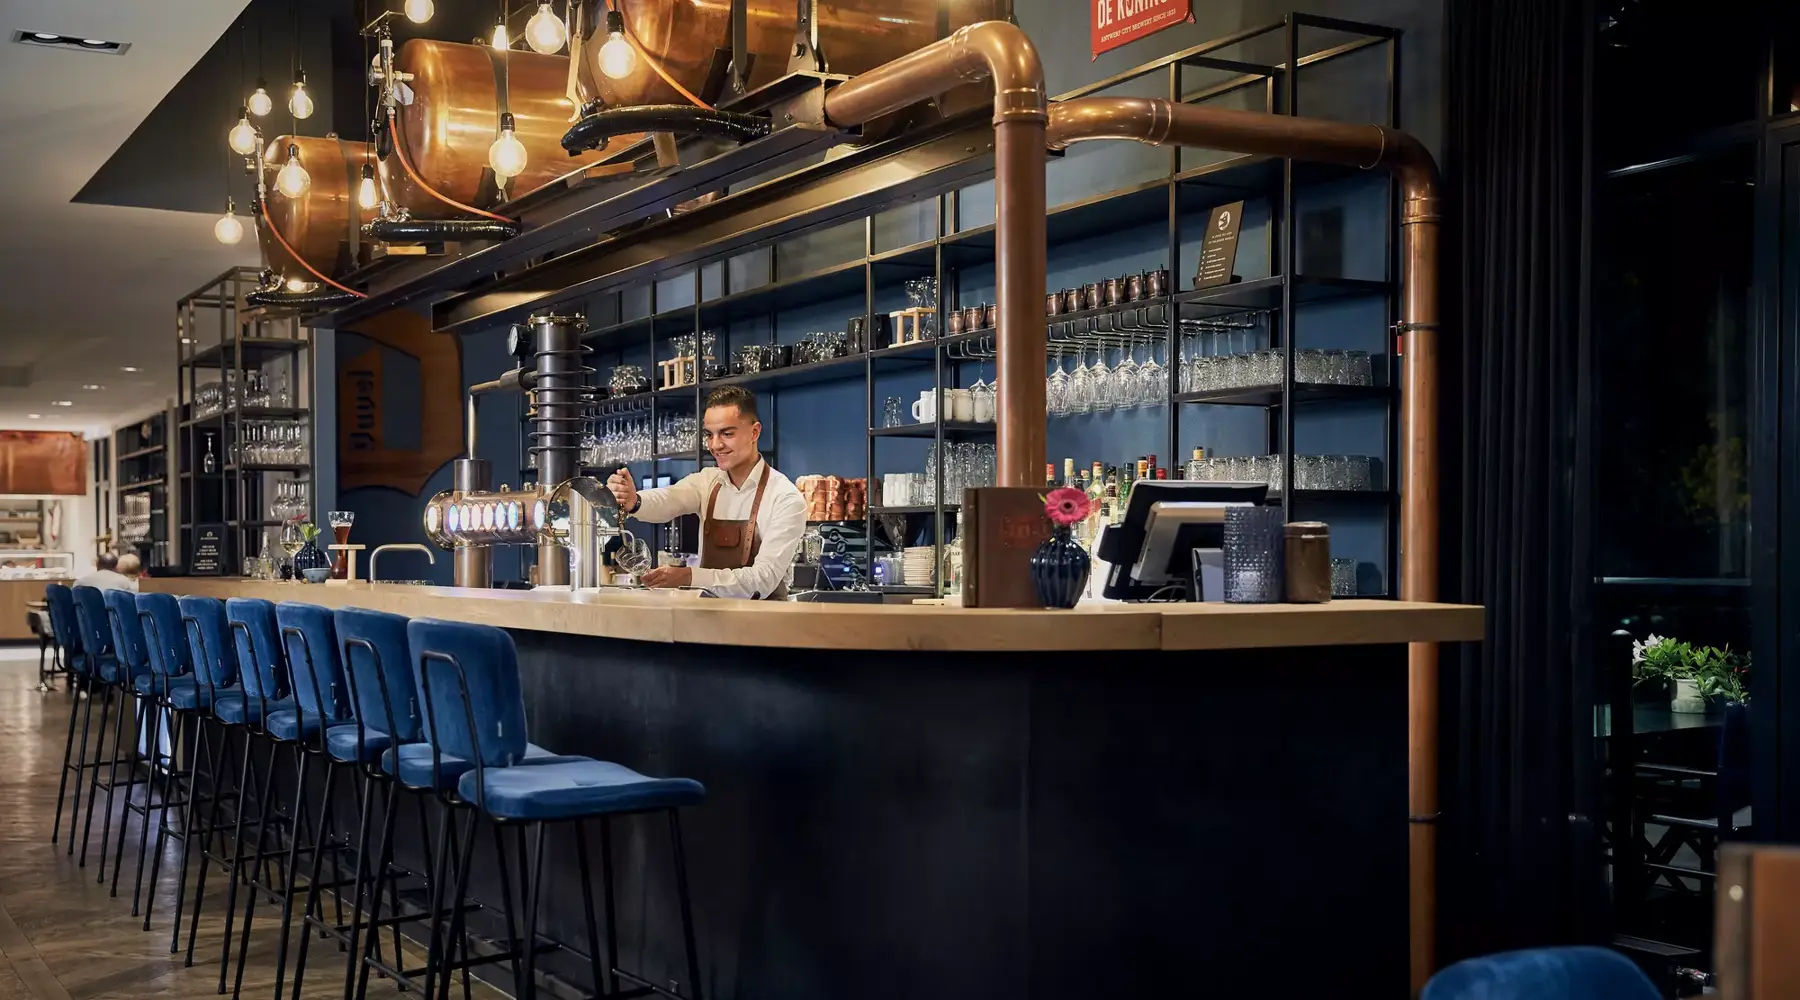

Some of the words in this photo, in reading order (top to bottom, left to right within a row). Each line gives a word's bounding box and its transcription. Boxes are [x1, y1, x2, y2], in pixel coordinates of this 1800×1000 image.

[1098, 0, 1113, 29] DE
[1121, 25, 1132, 35] CITY
[1152, 12, 1167, 23] SINCE
